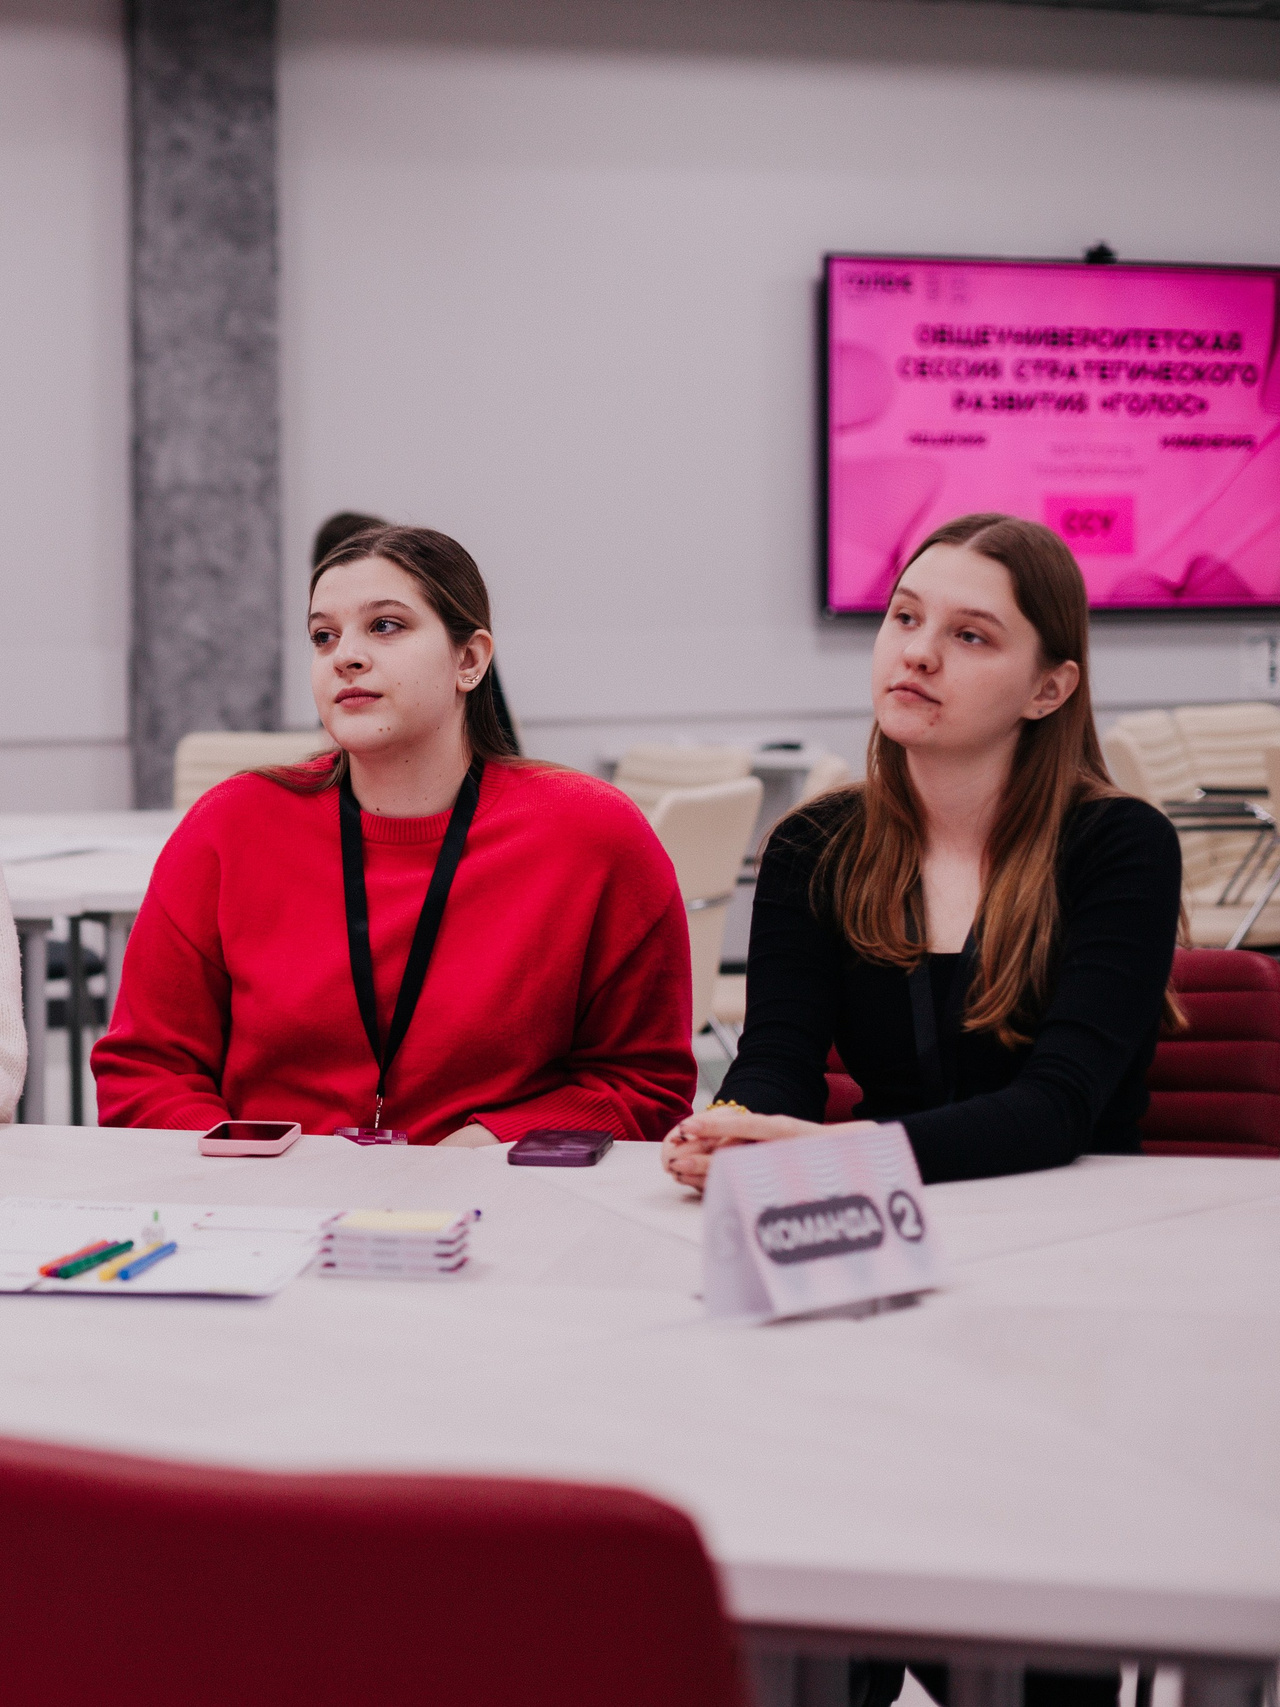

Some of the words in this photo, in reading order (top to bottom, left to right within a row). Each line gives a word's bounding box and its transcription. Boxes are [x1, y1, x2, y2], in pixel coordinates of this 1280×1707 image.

[897, 356, 1003, 382] СЕССИЯ
[951, 390, 1089, 415] РАЗВИТИЯ
[757, 1205, 883, 1252] КОМАНДА
[891, 1194, 922, 1240] 2
